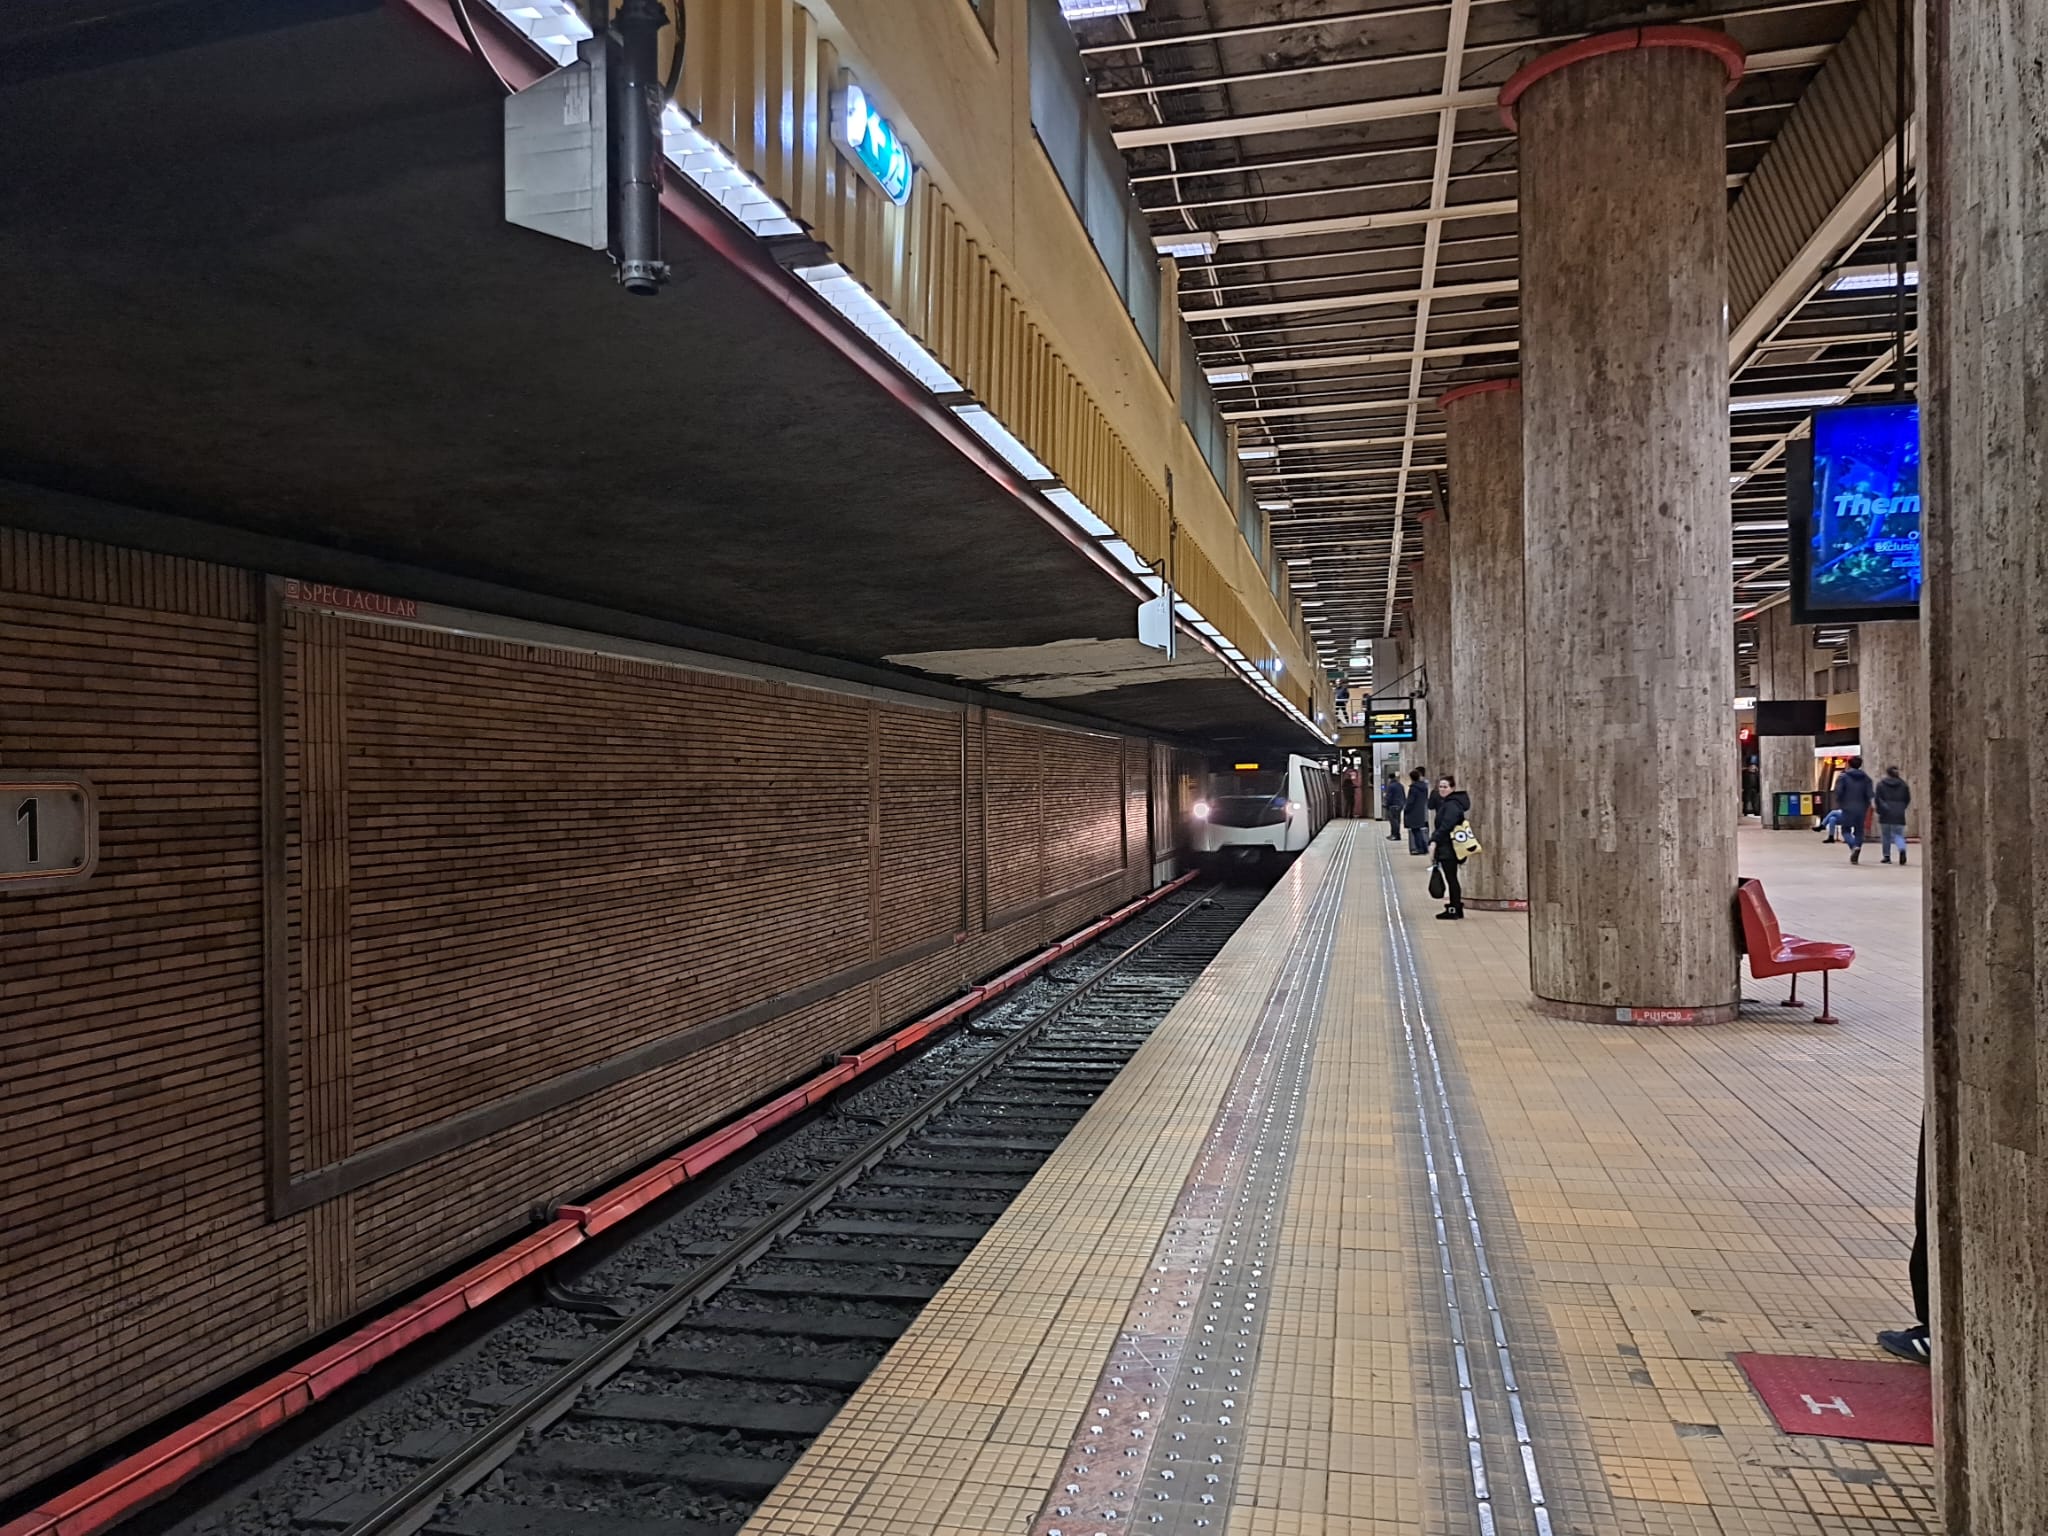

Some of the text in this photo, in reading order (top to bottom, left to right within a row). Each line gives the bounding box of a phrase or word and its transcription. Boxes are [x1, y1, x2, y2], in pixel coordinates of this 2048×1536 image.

[303, 583, 416, 617] SPECTACULAR
[16, 797, 40, 864] 1
[1800, 1394, 1855, 1417] H
